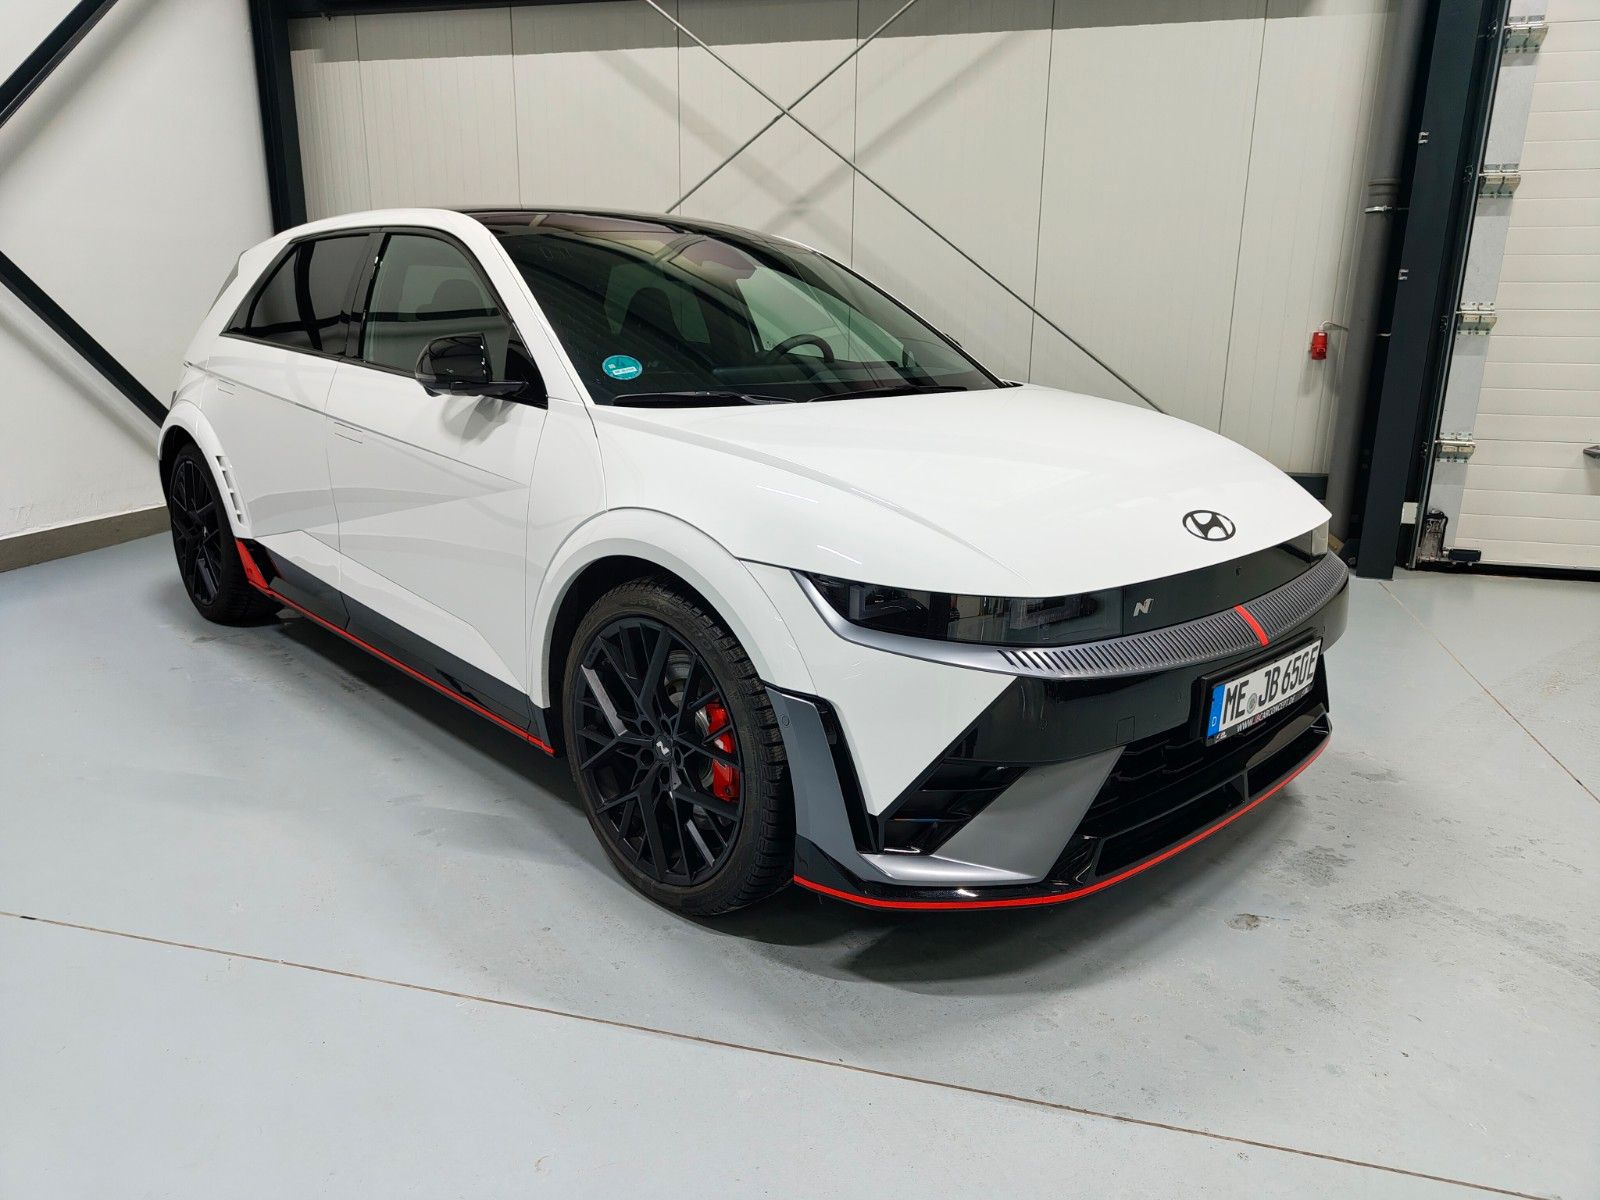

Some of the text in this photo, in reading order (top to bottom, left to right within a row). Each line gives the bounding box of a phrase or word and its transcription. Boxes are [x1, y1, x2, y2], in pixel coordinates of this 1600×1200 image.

[1222, 645, 1319, 724] ME JB 650E
